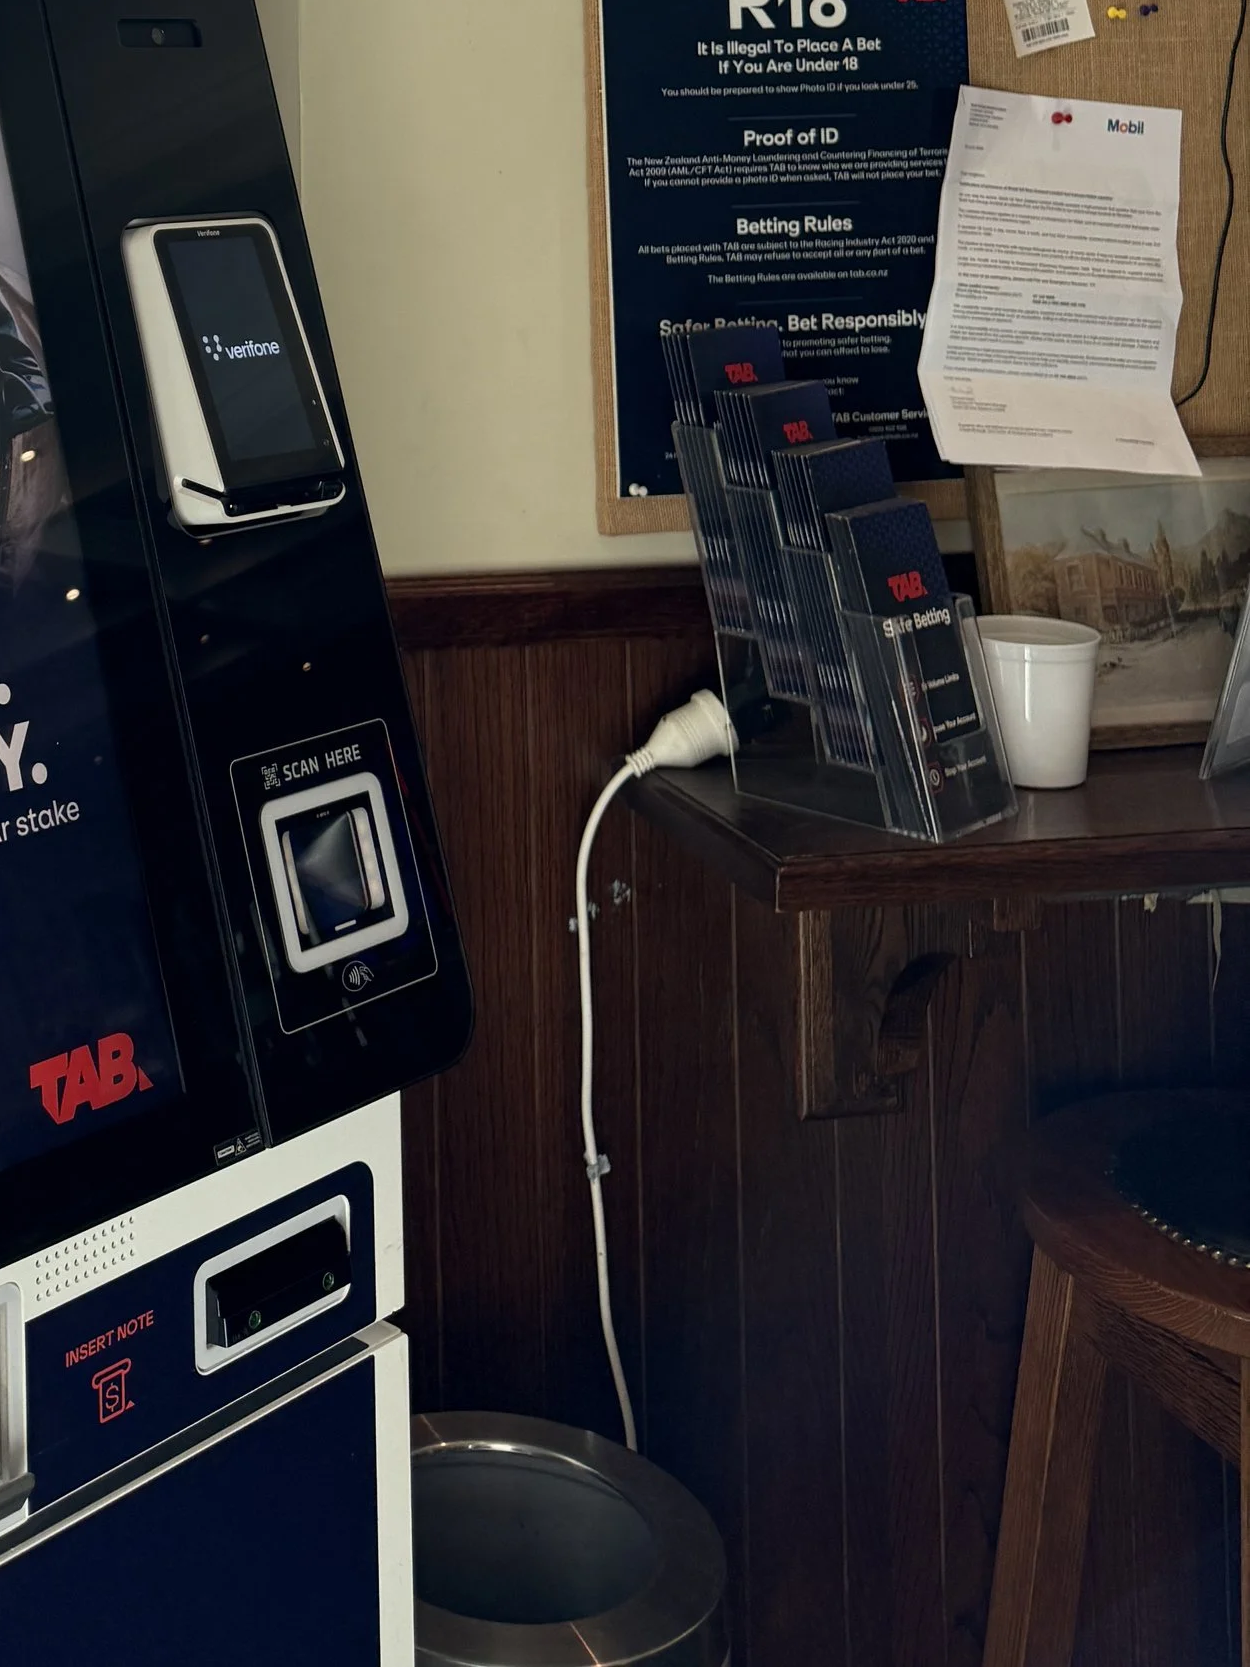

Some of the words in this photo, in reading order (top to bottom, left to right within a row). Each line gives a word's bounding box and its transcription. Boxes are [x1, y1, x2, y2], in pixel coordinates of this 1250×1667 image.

[697, 41, 708, 56] It
[711, 41, 724, 56] Is
[727, 39, 771, 57] Illegal
[774, 40, 793, 54] To
[797, 38, 838, 53] Place
[842, 38, 852, 52] A
[856, 37, 881, 51] Bet
[718, 60, 728, 75] If
[732, 60, 763, 74] You
[767, 59, 792, 73] Are
[795, 57, 840, 72] Under
[842, 56, 858, 71] 18
[662, 88, 678, 97] You
[680, 86, 709, 96] should
[711, 86, 721, 96] be
[723, 85, 763, 96] prepared
[765, 85, 774, 94] to
[776, 84, 799, 94] show
[801, 84, 825, 93] Photo
[827, 83, 836, 92] ID
[837, 83, 843, 92] if
[844, 83, 860, 93] you
[862, 82, 879, 91] look
[881, 81, 905, 90] under
[744, 129, 792, 146] Proof
[798, 128, 817, 145] of
[821, 127, 839, 144] ID
[1108, 119, 1144, 135] Mobil
[736, 217, 800, 237] Betting
[804, 215, 853, 233] Rules
[708, 274, 724, 284] The
[725, 274, 755, 284] Betting
[757, 273, 780, 282] Rules
[782, 273, 796, 281] are
[797, 270, 836, 281] available
[788, 314, 817, 331] Bet
[822, 309, 927, 333] Responsibly
[225, 339, 280, 360] verifone
[852, 410, 899, 423] Customer
[901, 408, 928, 420] Servi
[913, 607, 950, 629] Betting
[283, 755, 320, 782] SCAN
[325, 744, 362, 770] HERE
[15, 800, 81, 838] stake
[64, 1330, 114, 1368] INSERT
[116, 1310, 155, 1342] NOTE
